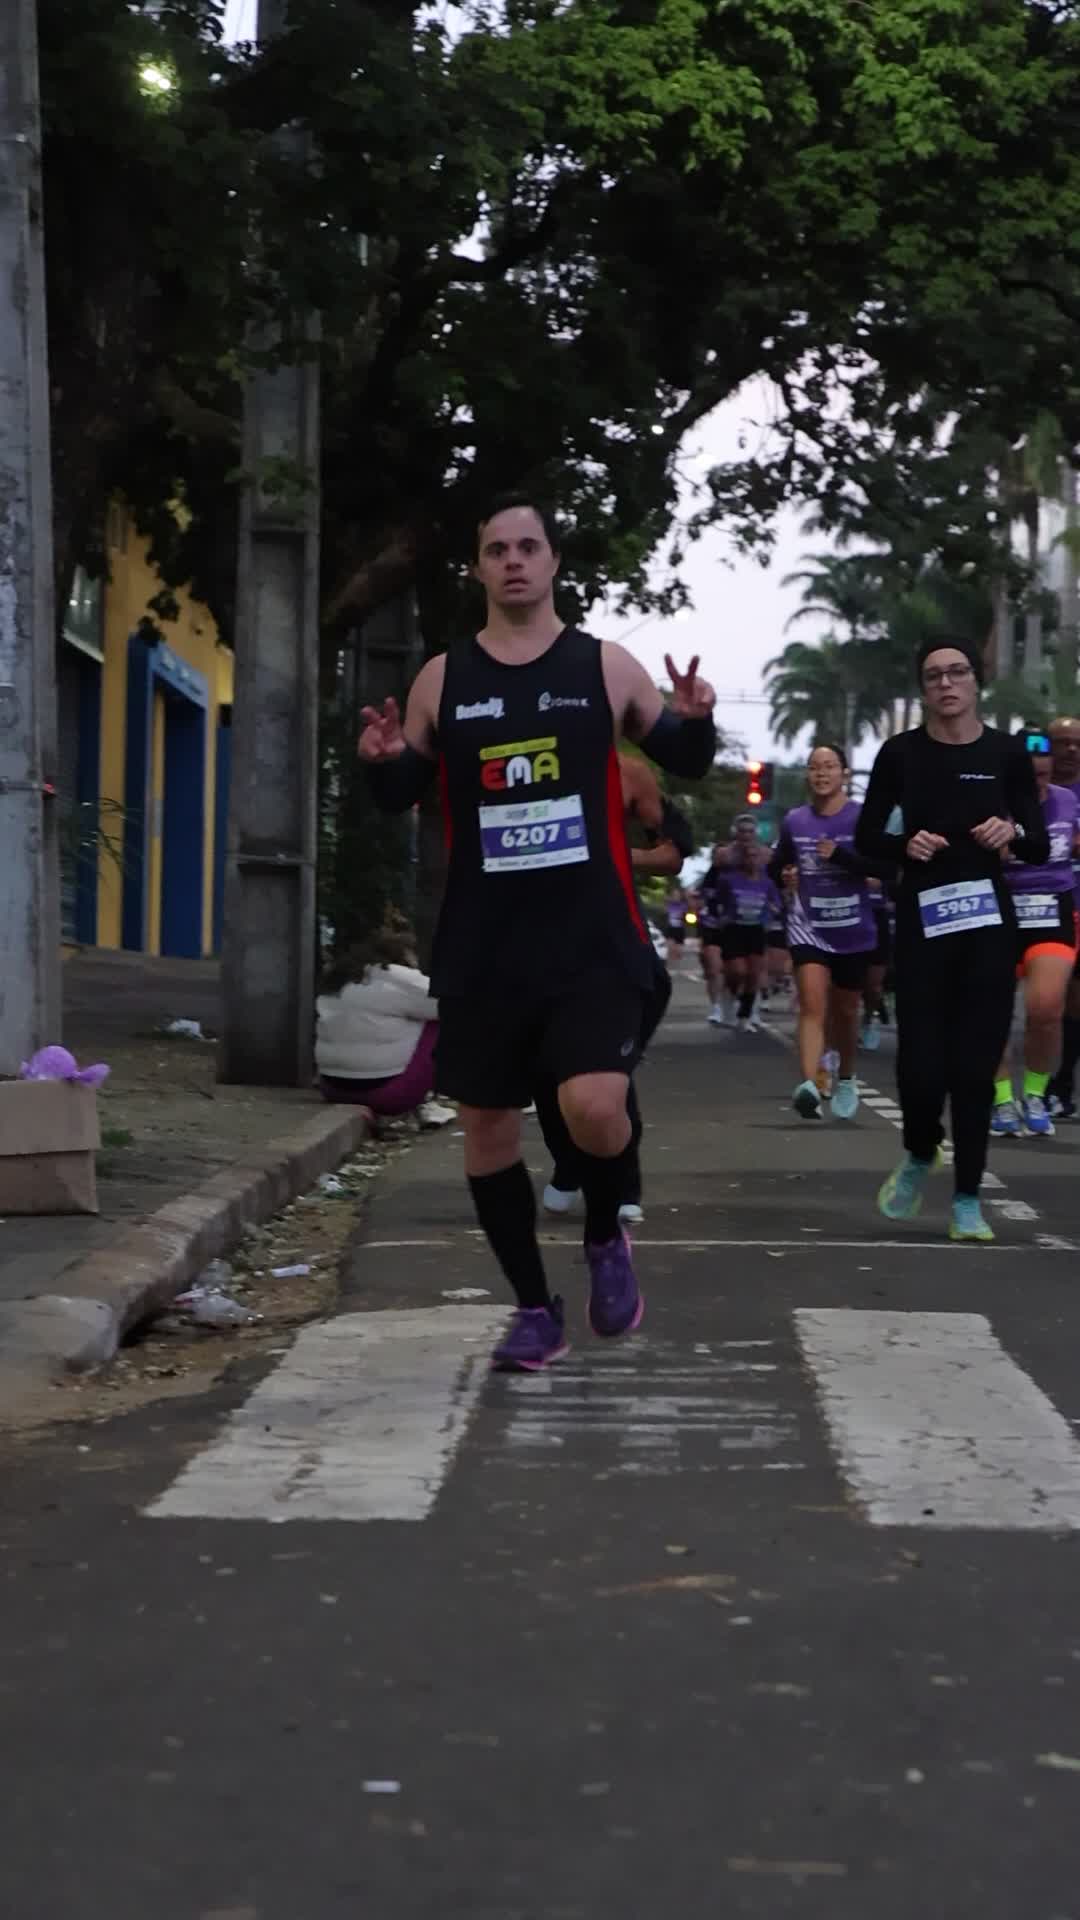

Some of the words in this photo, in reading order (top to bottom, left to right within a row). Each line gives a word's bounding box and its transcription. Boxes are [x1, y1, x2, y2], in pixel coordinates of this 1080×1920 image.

[481, 751, 560, 791] EMA
[501, 823, 560, 848] 6207
[937, 897, 981, 917] 5967
